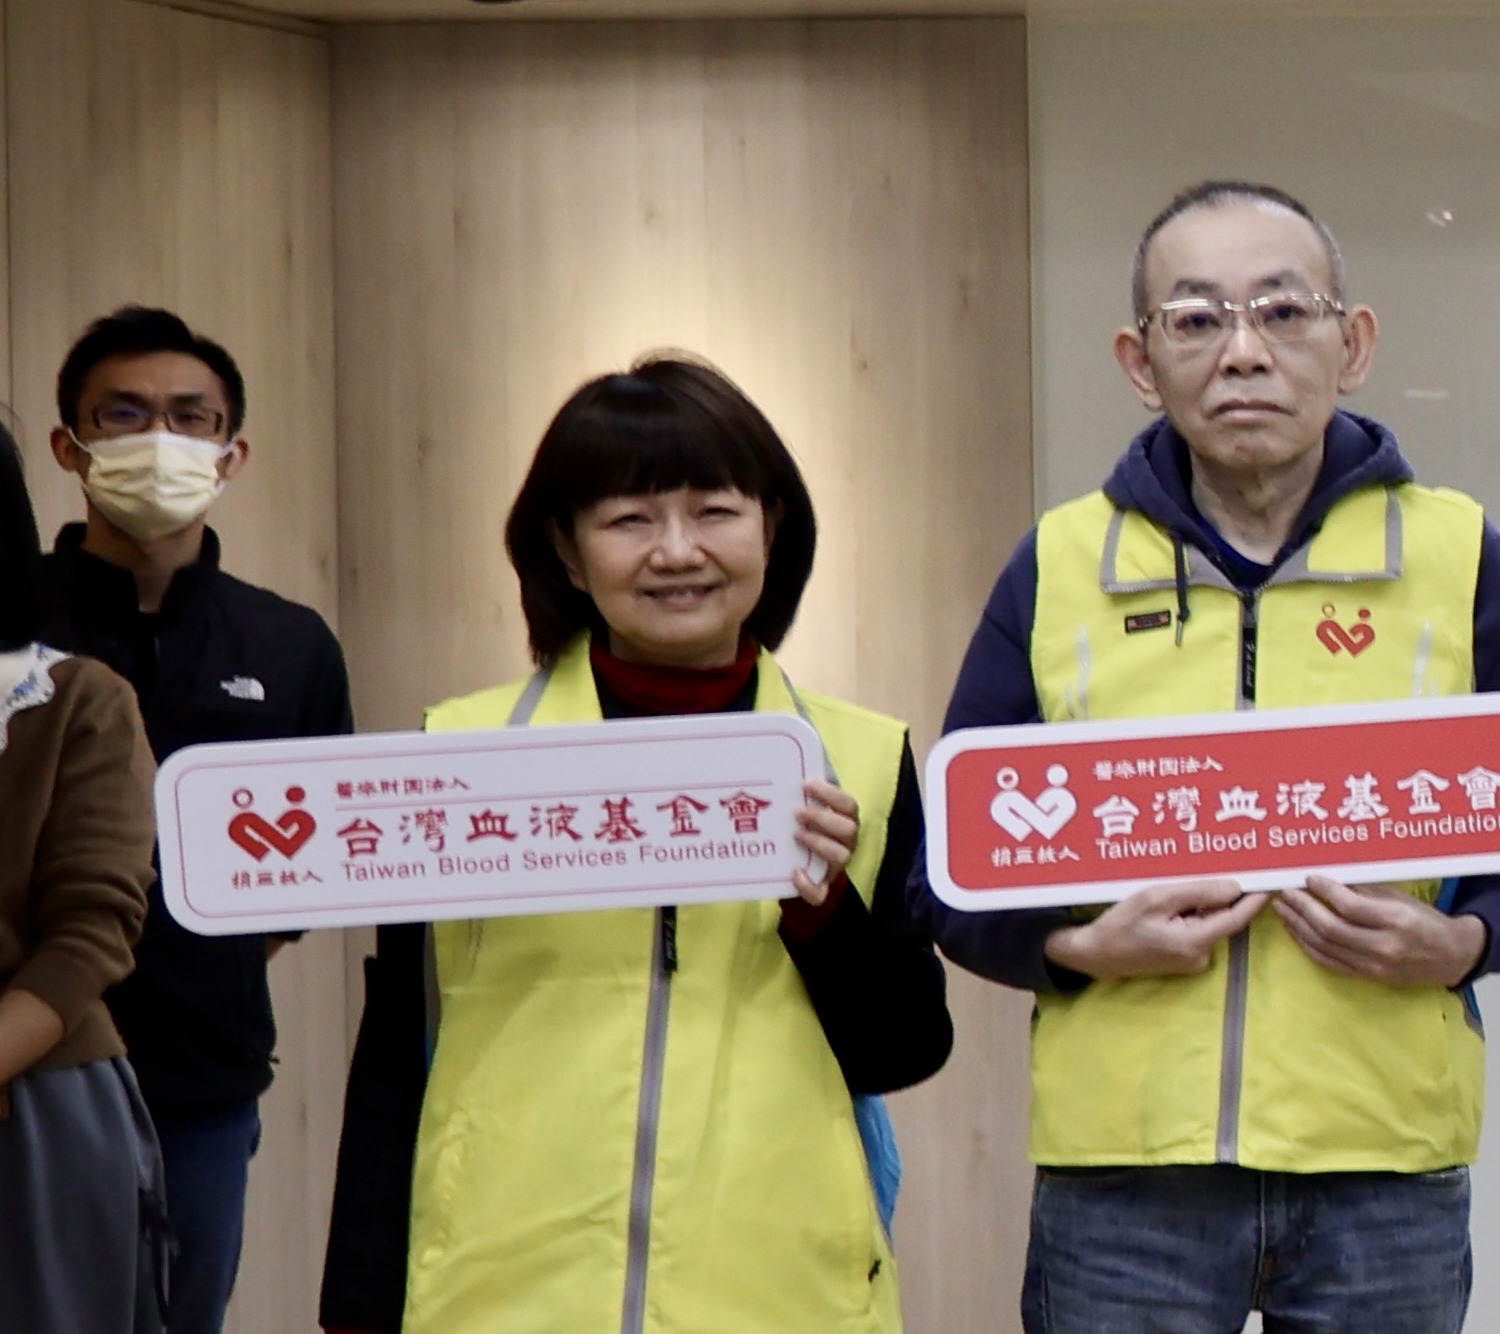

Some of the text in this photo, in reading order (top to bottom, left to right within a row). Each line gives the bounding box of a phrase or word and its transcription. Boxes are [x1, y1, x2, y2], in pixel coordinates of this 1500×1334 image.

[336, 791, 773, 858] 台灣血液基金會
[1096, 836, 1177, 859] Taiwan
[1188, 828, 1257, 853] Blood
[1269, 820, 1368, 847] Services
[342, 836, 777, 882] Taiwan Blood Services Foundation
